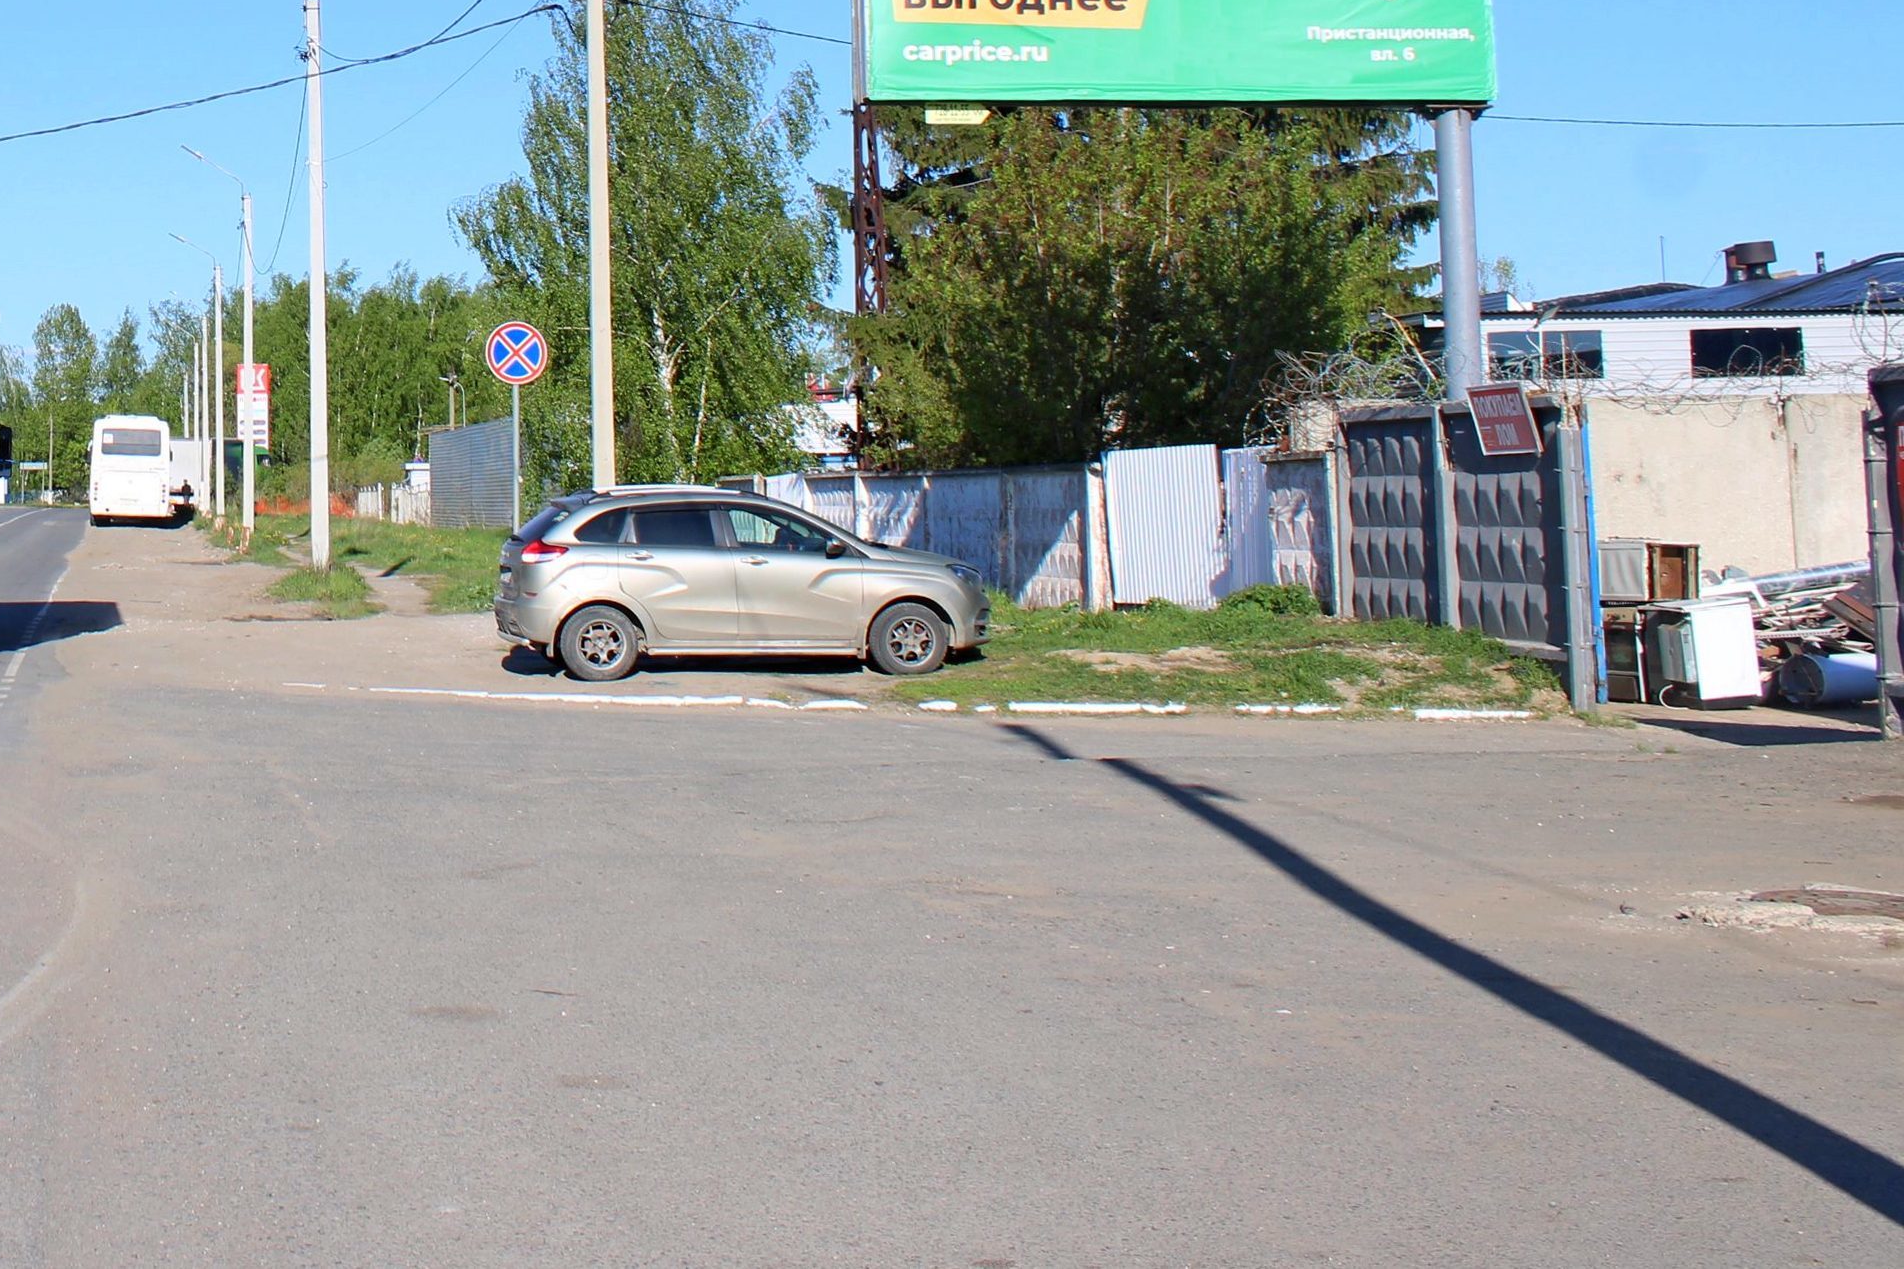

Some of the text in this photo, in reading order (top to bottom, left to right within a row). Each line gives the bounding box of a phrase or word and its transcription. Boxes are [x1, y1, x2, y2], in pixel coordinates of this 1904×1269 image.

[1307, 26, 1475, 43] Пристанционная,
[902, 39, 1049, 66] carprice.ru
[1370, 47, 1416, 62] вл. 6
[1473, 394, 1525, 418] ПОКУПАЕМ
[1495, 423, 1520, 445] ЛОМ
